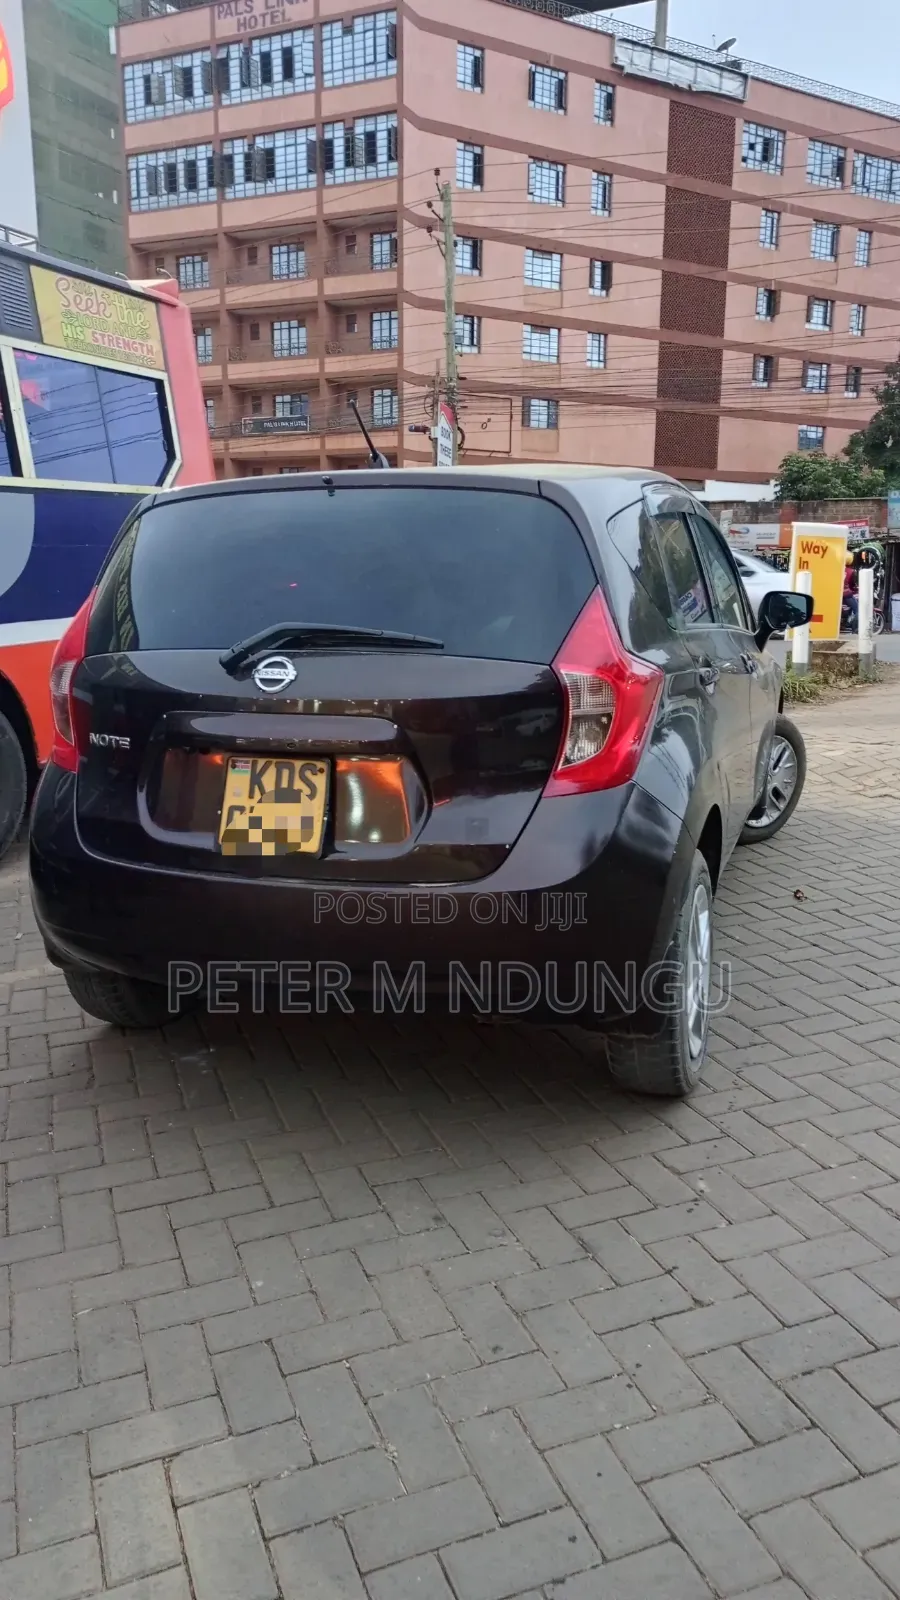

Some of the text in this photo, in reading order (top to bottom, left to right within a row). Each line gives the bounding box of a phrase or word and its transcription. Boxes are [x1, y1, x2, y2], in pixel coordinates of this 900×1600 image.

[217, 0, 254, 19] PALS
[236, 8, 293, 32] HOTEL
[55, 277, 150, 330] Seek the
[61, 321, 155, 356] HIS STRENGTH
[801, 540, 829, 558] Way
[798, 556, 809, 570] In
[253, 668, 291, 679] NISSAN
[89, 732, 131, 749] NOTE
